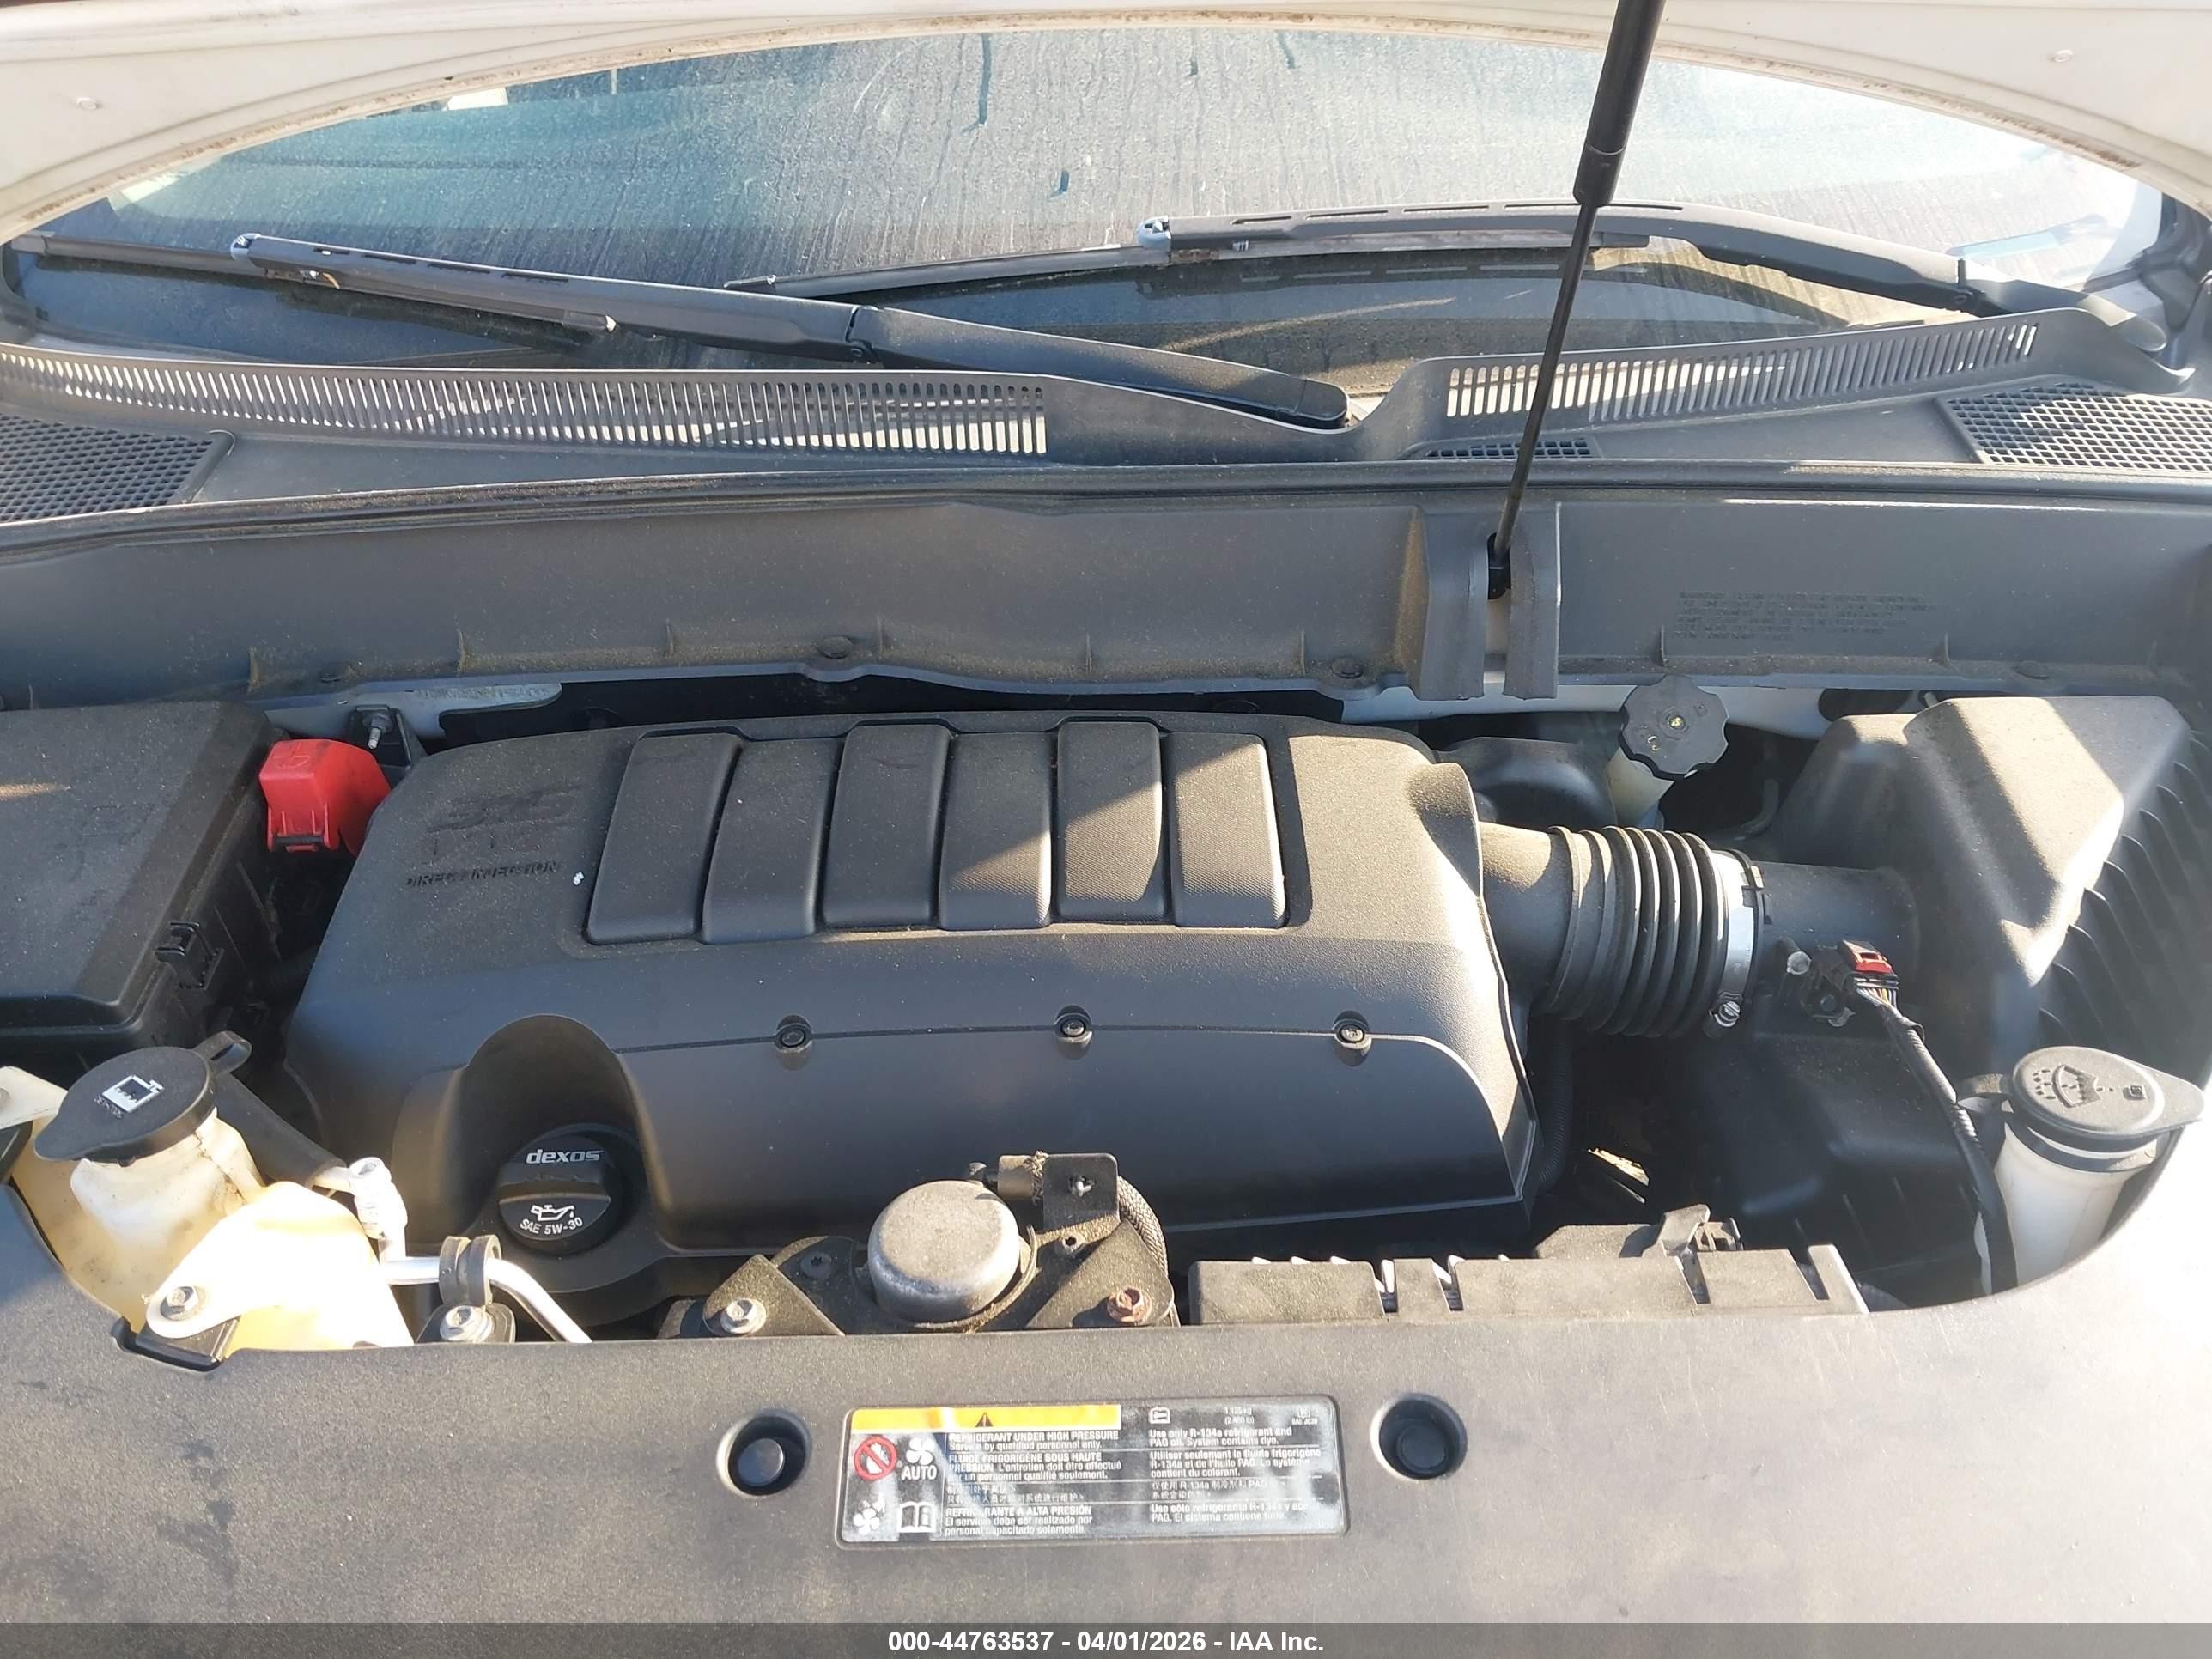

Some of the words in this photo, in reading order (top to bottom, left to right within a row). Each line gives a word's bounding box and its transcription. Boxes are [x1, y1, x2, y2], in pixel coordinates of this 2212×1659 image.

[526, 1149, 605, 1164] dexos
[520, 1218, 543, 1234] SAE
[544, 1216, 583, 1235] 5W-30
[948, 1432, 1012, 1443] REFRIGERANT
[1013, 1432, 1045, 1442] UNDER
[1046, 1431, 1070, 1442] HIGH
[1071, 1431, 1119, 1440] PRESSURE
[1150, 1429, 1167, 1438] Use
[1169, 1429, 1188, 1439] only
[1189, 1428, 1222, 1437] R-134a
[1275, 1426, 1292, 1437] and
[984, 1443, 995, 1453] by
[996, 1442, 1035, 1452] qualified
[1036, 1442, 1080, 1452] personnel
[1082, 1441, 1103, 1451] only.
[1187, 1437, 1220, 1449] System
[1221, 1437, 1260, 1446] contains
[1261, 1436, 1279, 1446] dye.
[1045, 1453, 1070, 1462] SOUS
[1072, 1452, 1102, 1462] HAUTE
[1151, 1451, 1182, 1460] Utiliser
[1184, 1449, 1231, 1459] seulement
[1233, 1449, 1243, 1458] le
[1272, 1447, 1322, 1460] frigorigène
[999, 1462, 1045, 1472] L'entretien
[1047, 1462, 1064, 1471] doit
[1066, 1461, 1084, 1470] être
[1085, 1460, 1122, 1470] effectué
[1151, 1460, 1183, 1469] R-134a
[1185, 1460, 1194, 1468] et
[1195, 1460, 1207, 1468] de
[901, 1464, 938, 1481] AUTO
[978, 1472, 1022, 1482] personnel
[1024, 1471, 1058, 1482] qualifié
[1059, 1470, 1108, 1480] seulement.
[1151, 1468, 1187, 1478] contient
[1188, 1468, 1200, 1477] du
[1202, 1468, 1240, 1477] colorant.
[1026, 1506, 1049, 1516] ALTA
[1051, 1504, 1092, 1516] PRESIÓN
[1152, 1504, 1169, 1513] Use
[1170, 1503, 1190, 1513] sólo
[1192, 1503, 1248, 1514] refrigerante
[945, 1518, 955, 1527] El
[994, 1516, 1015, 1526] debe
[1018, 1517, 1033, 1526] ser
[1034, 1516, 1076, 1525] realizado
[1078, 1516, 1092, 1526] por
[1175, 1512, 1183, 1522] El
[1036, 1524, 1085, 1535] solamente.
